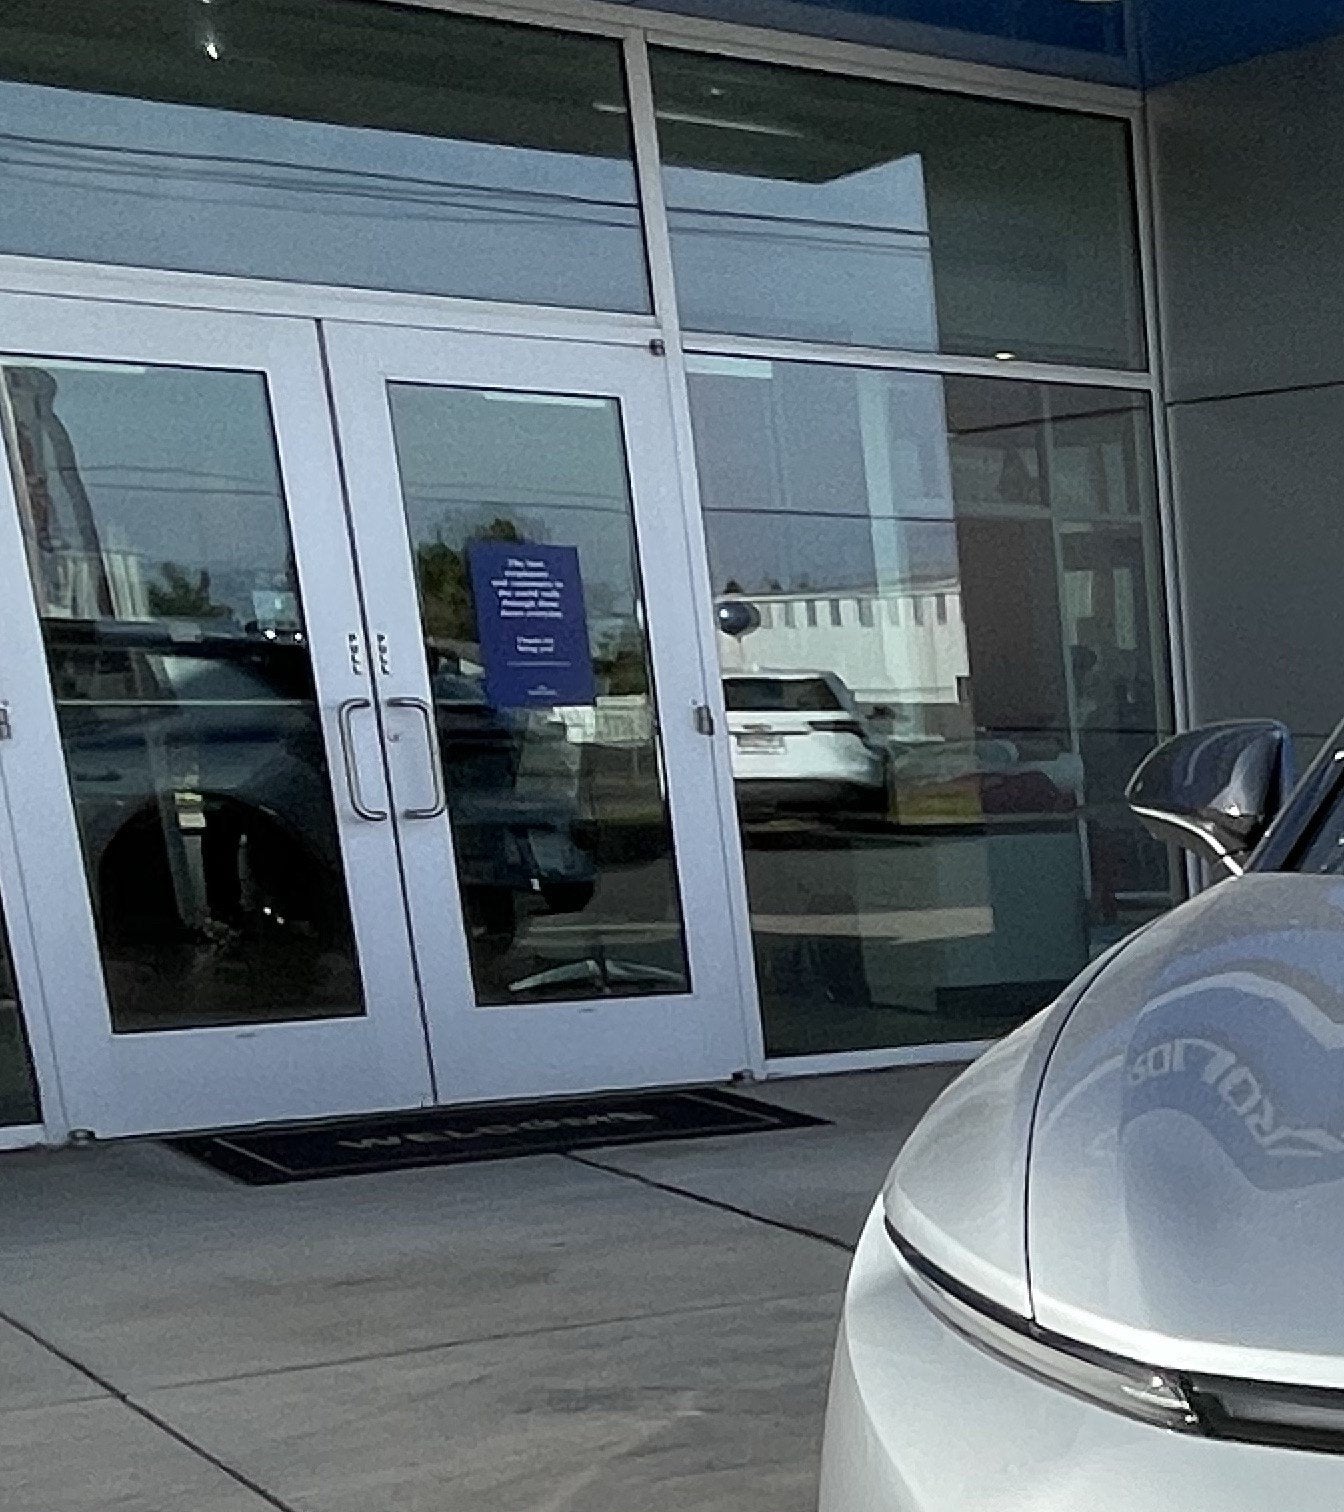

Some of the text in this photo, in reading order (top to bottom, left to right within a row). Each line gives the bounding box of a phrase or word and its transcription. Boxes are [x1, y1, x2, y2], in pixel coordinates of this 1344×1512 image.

[348, 633, 361, 675] PULL
[376, 633, 389, 675] PULL
[337, 1111, 655, 1148] WELCOME
